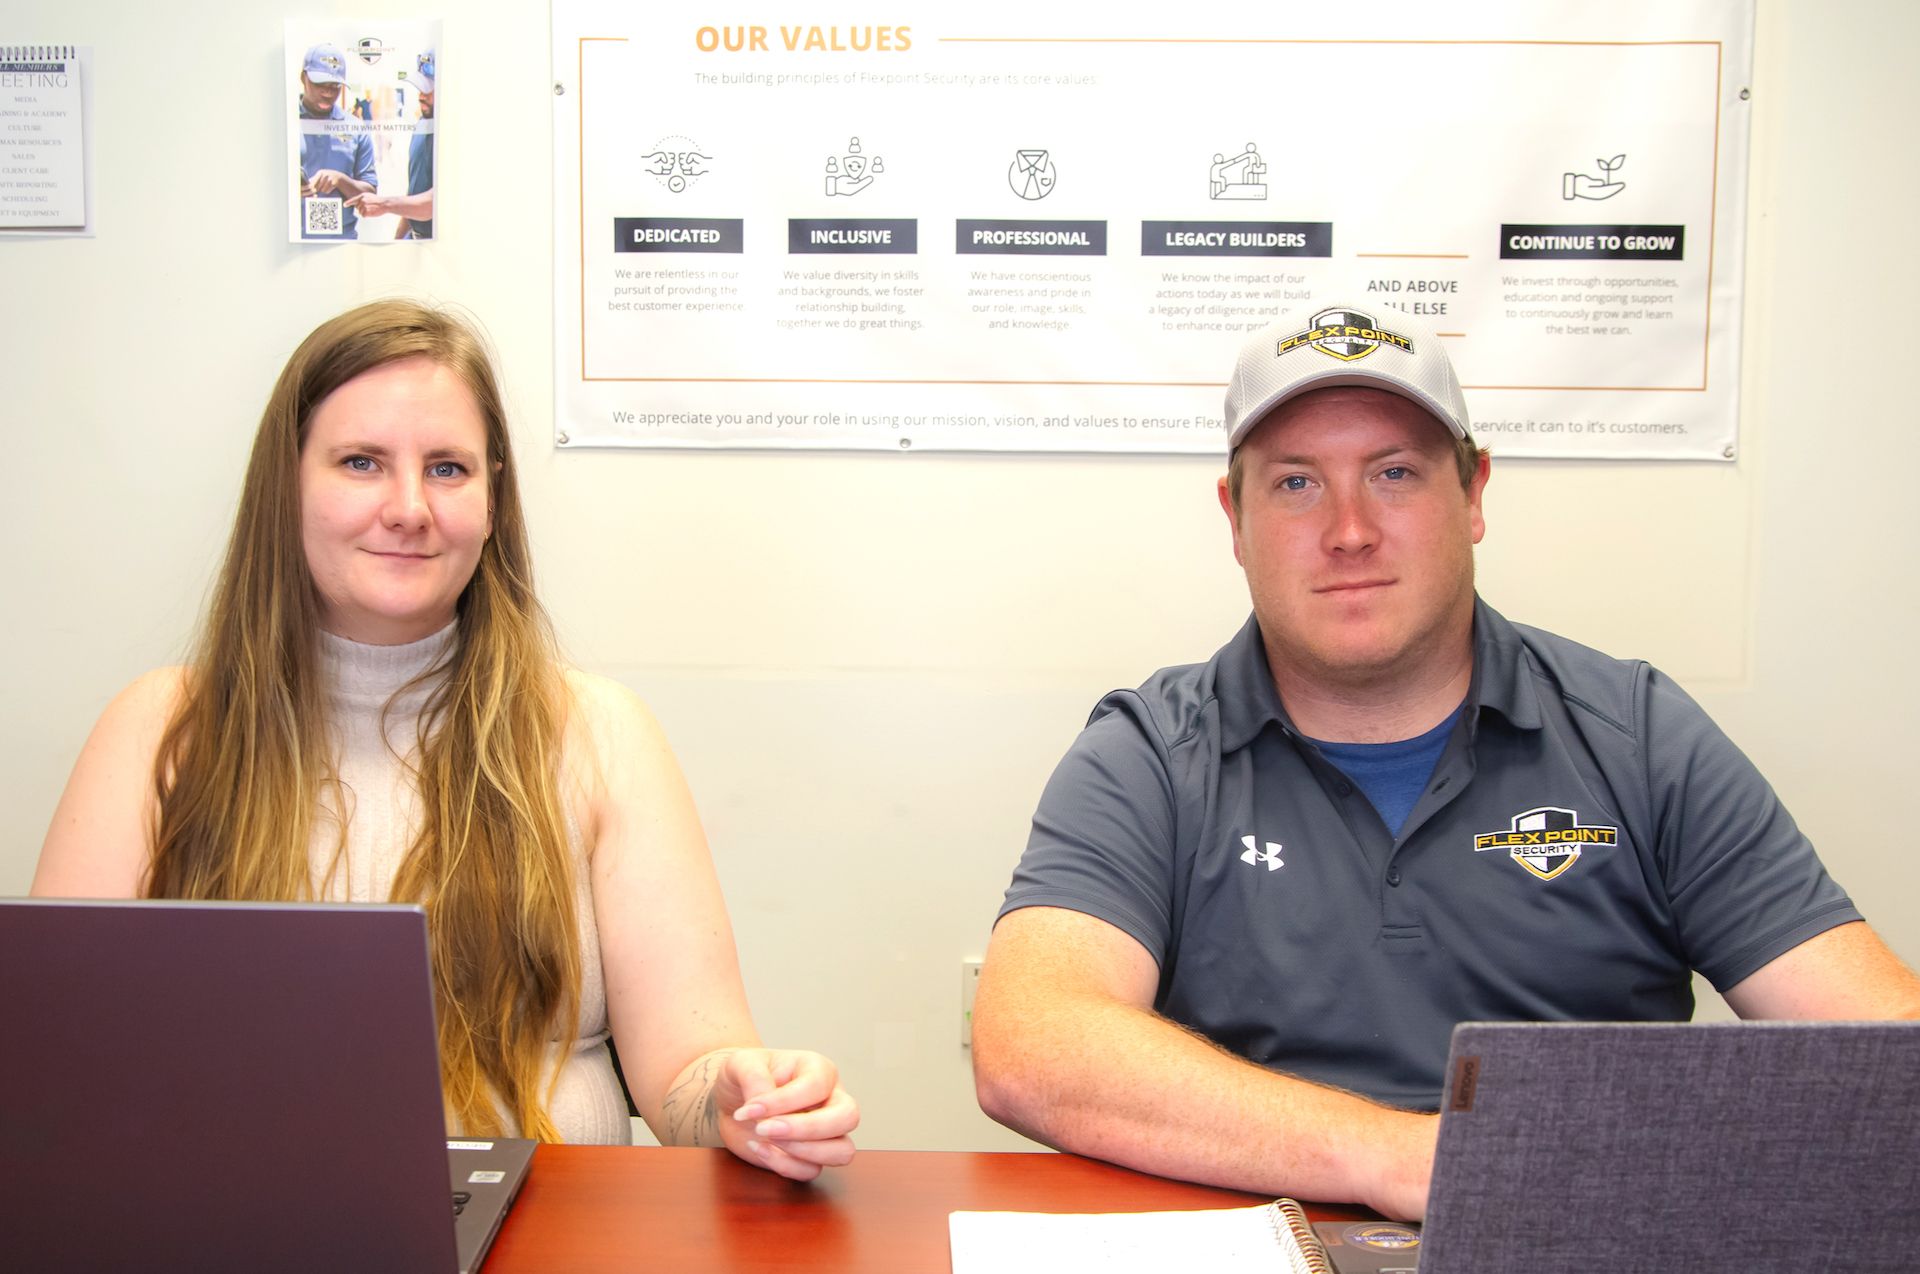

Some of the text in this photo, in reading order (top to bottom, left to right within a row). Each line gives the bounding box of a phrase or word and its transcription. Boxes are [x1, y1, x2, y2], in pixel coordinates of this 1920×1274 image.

[695, 25, 912, 52] OUR VALUES
[13, 63, 58, 71] MEMBERS
[694, 73, 718, 84] The
[722, 72, 775, 86] building
[777, 72, 840, 87] principles
[843, 72, 856, 84] of
[860, 72, 920, 87] Flexpoint
[923, 72, 976, 88] Security
[979, 75, 1000, 85] are
[1004, 73, 1019, 85] its
[1022, 75, 1051, 85] core
[323, 124, 417, 132] INVEST IN WHAT MATTERS
[634, 229, 720, 243] DEDICATED
[811, 230, 892, 244] INCLUSIVE
[973, 230, 1090, 245] PROFESSIONAL
[1166, 232, 1306, 247] LEGACY BUILDERS
[1510, 235, 1675, 250] CONTINUE TO GROW
[615, 269, 739, 280] We are relentless in our
[784, 270, 919, 282] We value diversity in skills
[971, 271, 1092, 282] We have conscientious
[1161, 273, 1306, 285] We know the impact of our
[1367, 280, 1458, 293] AND ABOVE
[1501, 275, 1679, 290] We invest through opportunities,
[614, 285, 738, 297] pursuit of providing the
[778, 286, 925, 298] and backgrounds, we foster
[968, 288, 1091, 300] awareness and pride in
[1155, 288, 1311, 301] actions today as we will build
[1503, 292, 1674, 306] education and ongoing support
[608, 301, 631, 311] best
[633, 302, 682, 312] customer
[795, 302, 906, 315] relationship building,
[972, 303, 1087, 316] our role, image, skills,
[1148, 306, 1155, 314] a
[1158, 304, 1192, 317] legacy
[1194, 304, 1206, 315] of
[1208, 304, 1256, 317] diligence
[1257, 306, 1278, 315] and
[1414, 302, 1447, 315] ELSE
[1505, 307, 1673, 322] to continuously grow and learn
[777, 317, 925, 331] together we do great things.
[989, 319, 1009, 328] and
[1162, 322, 1173, 330] to
[1176, 321, 1222, 331] enhance
[1225, 322, 1244, 331] our
[1546, 324, 1632, 335] the best we can.
[1279, 326, 1409, 353] FLEX POINT
[613, 411, 635, 423] We
[639, 411, 712, 427] appreciate
[716, 414, 742, 428] you
[746, 411, 772, 425] and
[777, 415, 809, 428] your
[813, 412, 840, 425] role
[845, 413, 857, 425] in
[862, 415, 899, 429] using
[904, 416, 928, 426] our
[931, 414, 990, 428] mission,
[993, 415, 1038, 428] vision,
[1043, 414, 1069, 427] and
[1073, 414, 1119, 428] values
[1123, 417, 1137, 428] to
[1141, 418, 1190, 429] ensure
[1473, 420, 1688, 435] service it can to it's customers.
[1477, 829, 1616, 848] FLEX POINT
[1513, 844, 1577, 855] SECURITY
